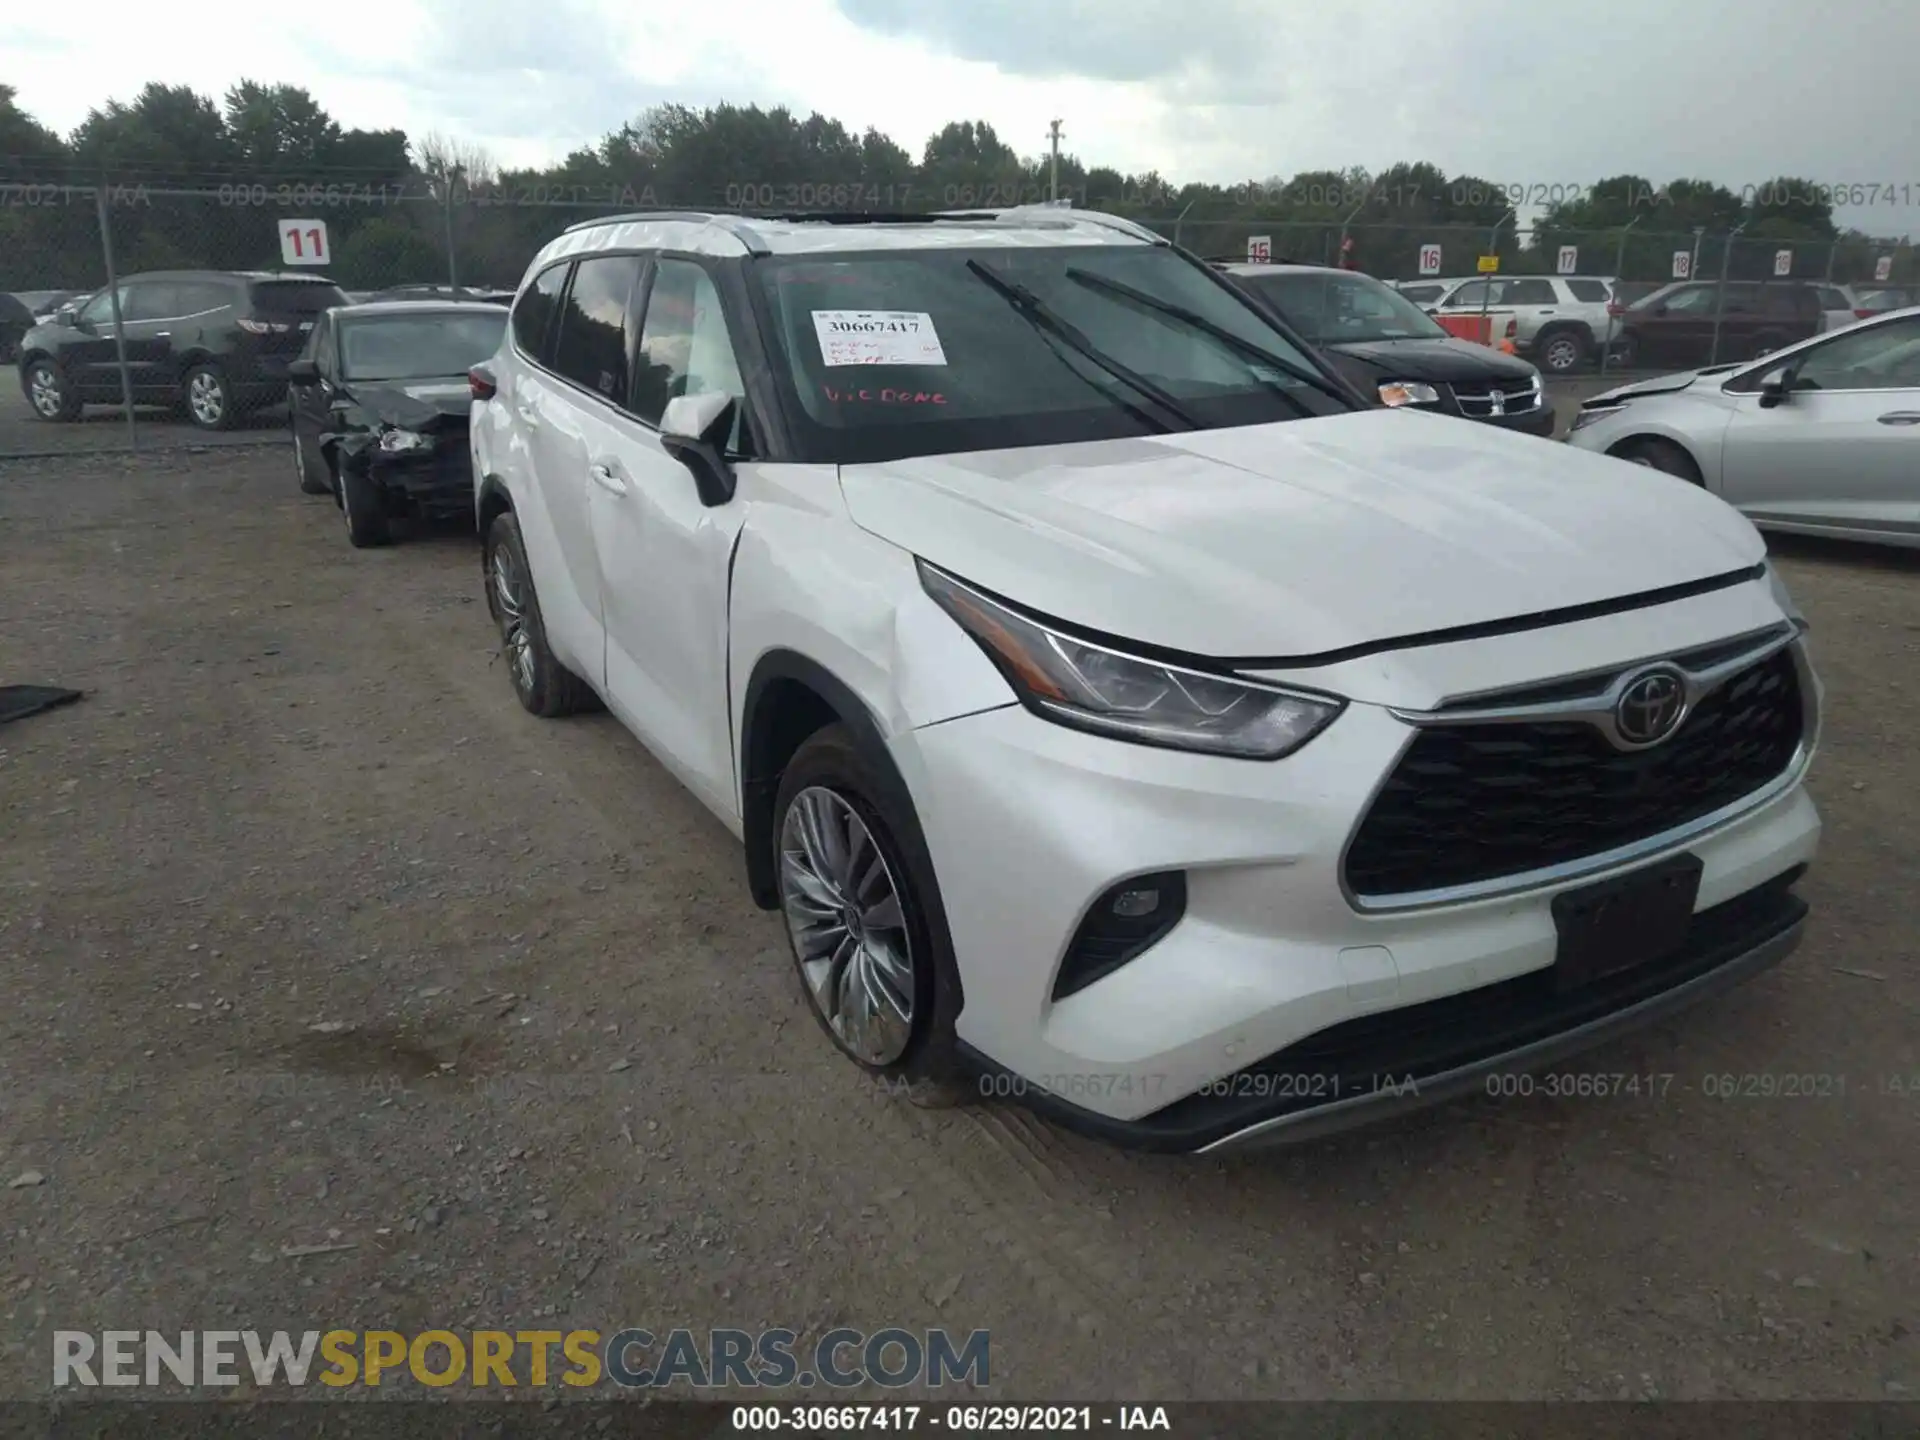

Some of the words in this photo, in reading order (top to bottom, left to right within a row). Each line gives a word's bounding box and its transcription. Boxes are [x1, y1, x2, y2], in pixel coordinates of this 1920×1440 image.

[286, 227, 323, 257] 11
[1423, 250, 1439, 269] 16
[1561, 252, 1576, 269] 17
[1676, 256, 1689, 273] 18
[829, 321, 919, 333] 30667417
